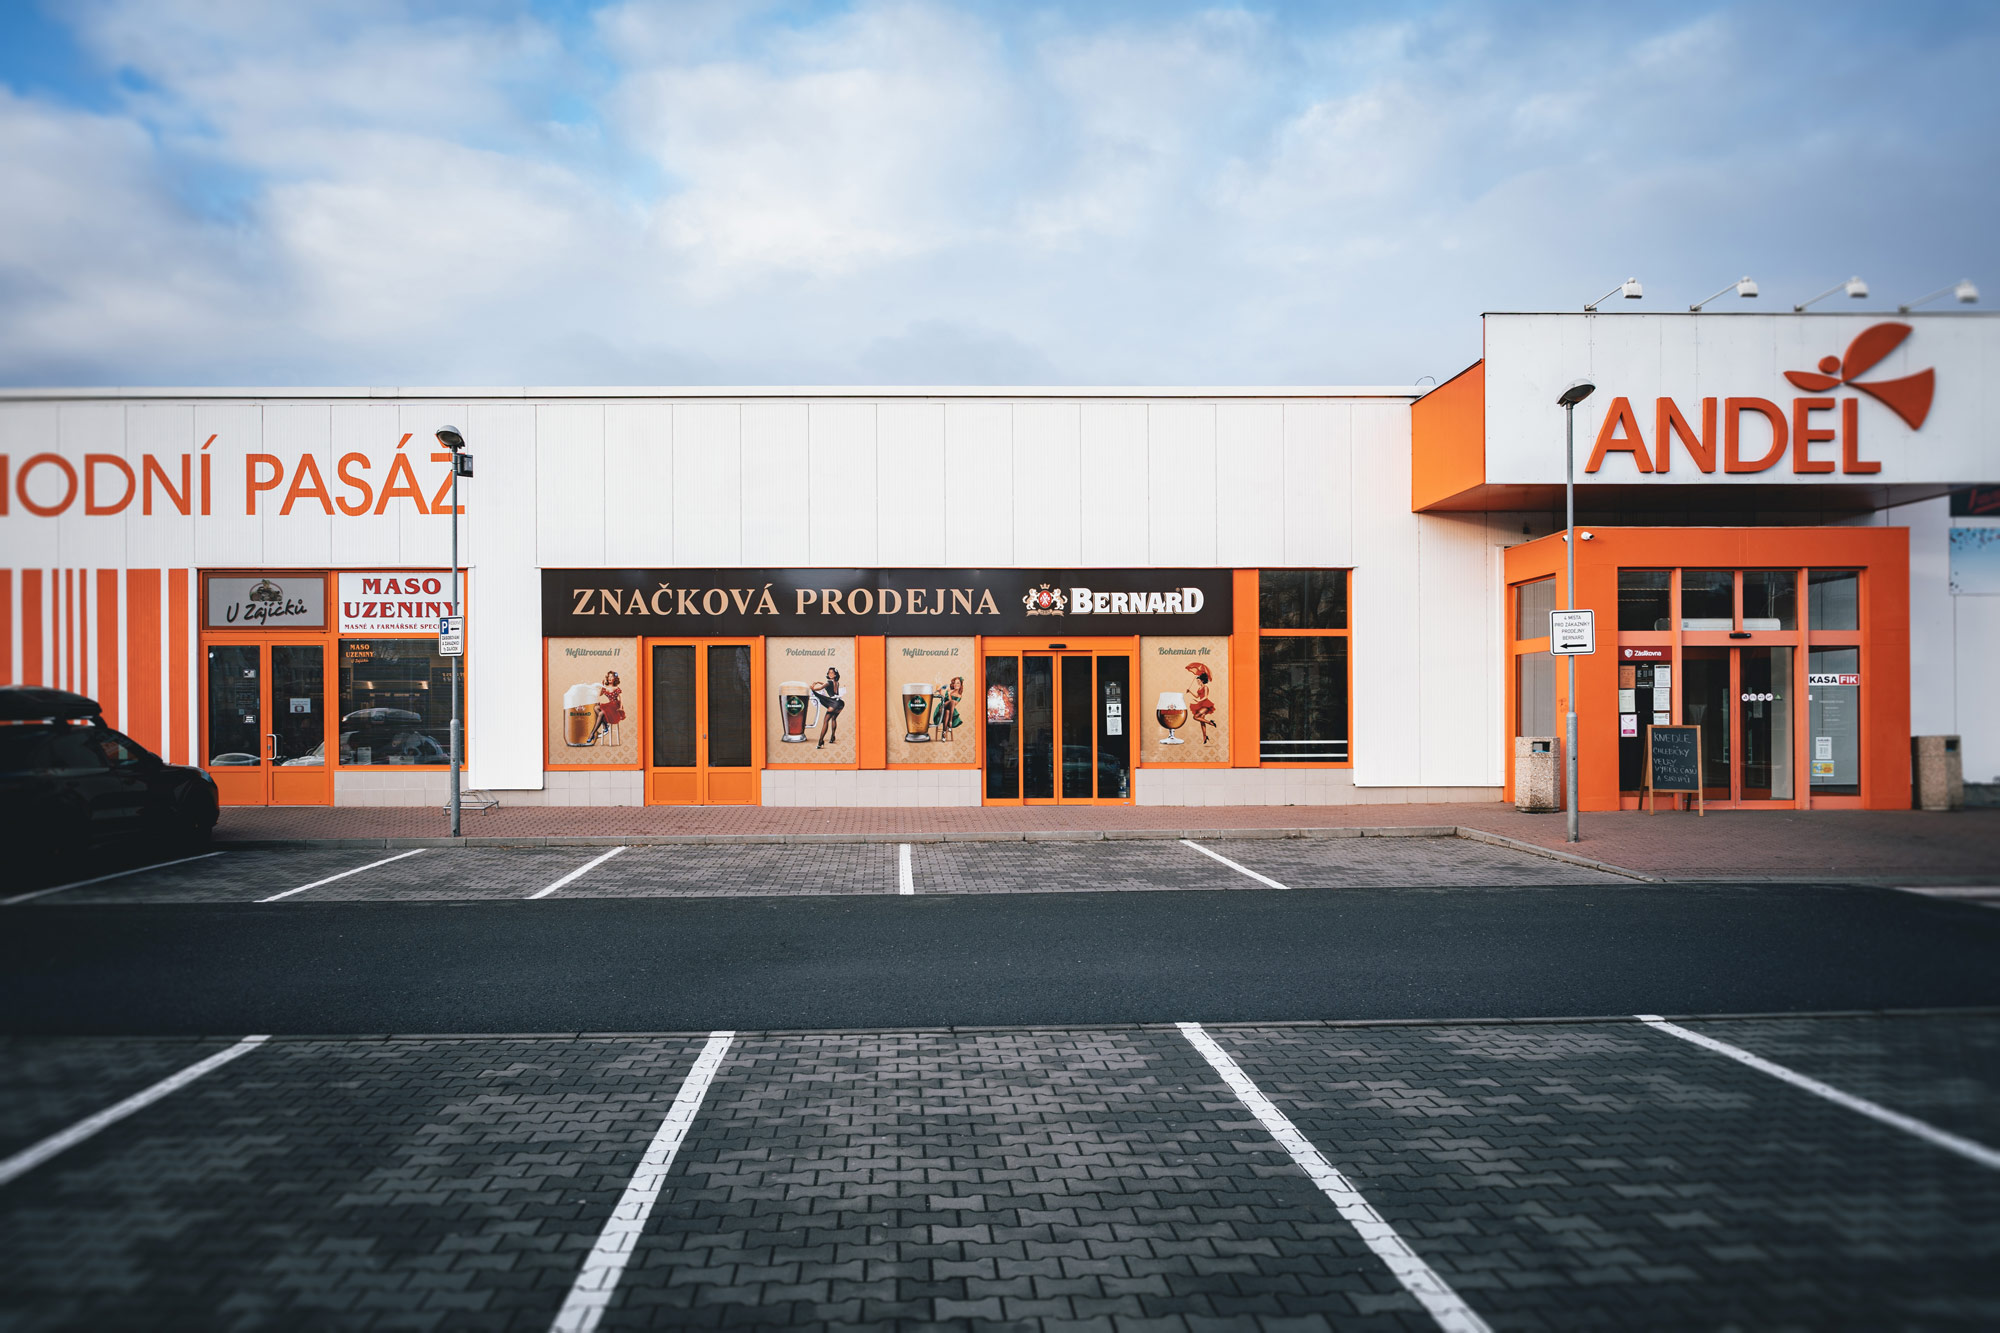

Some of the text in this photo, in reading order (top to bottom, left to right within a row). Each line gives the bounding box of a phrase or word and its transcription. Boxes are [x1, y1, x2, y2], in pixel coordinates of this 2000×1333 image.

[361, 577, 442, 595] MASO
[571, 582, 1000, 616] ZNAČKOVÁ PRODEJNA
[1069, 587, 1205, 615] BERNARD
[226, 598, 308, 625] U Zajíčků
[343, 601, 461, 618] UZENINY
[344, 622, 368, 630] MASNÉ
[377, 622, 418, 630] FARMÁŘSKÉ
[565, 648, 621, 658] Nefiltrovaná 11
[828, 648, 836, 656] 12
[902, 648, 959, 658] Nefiltrovaná 12
[1158, 647, 1211, 656] Bohemian Ale
[1654, 732, 1690, 743] KNEDLE
